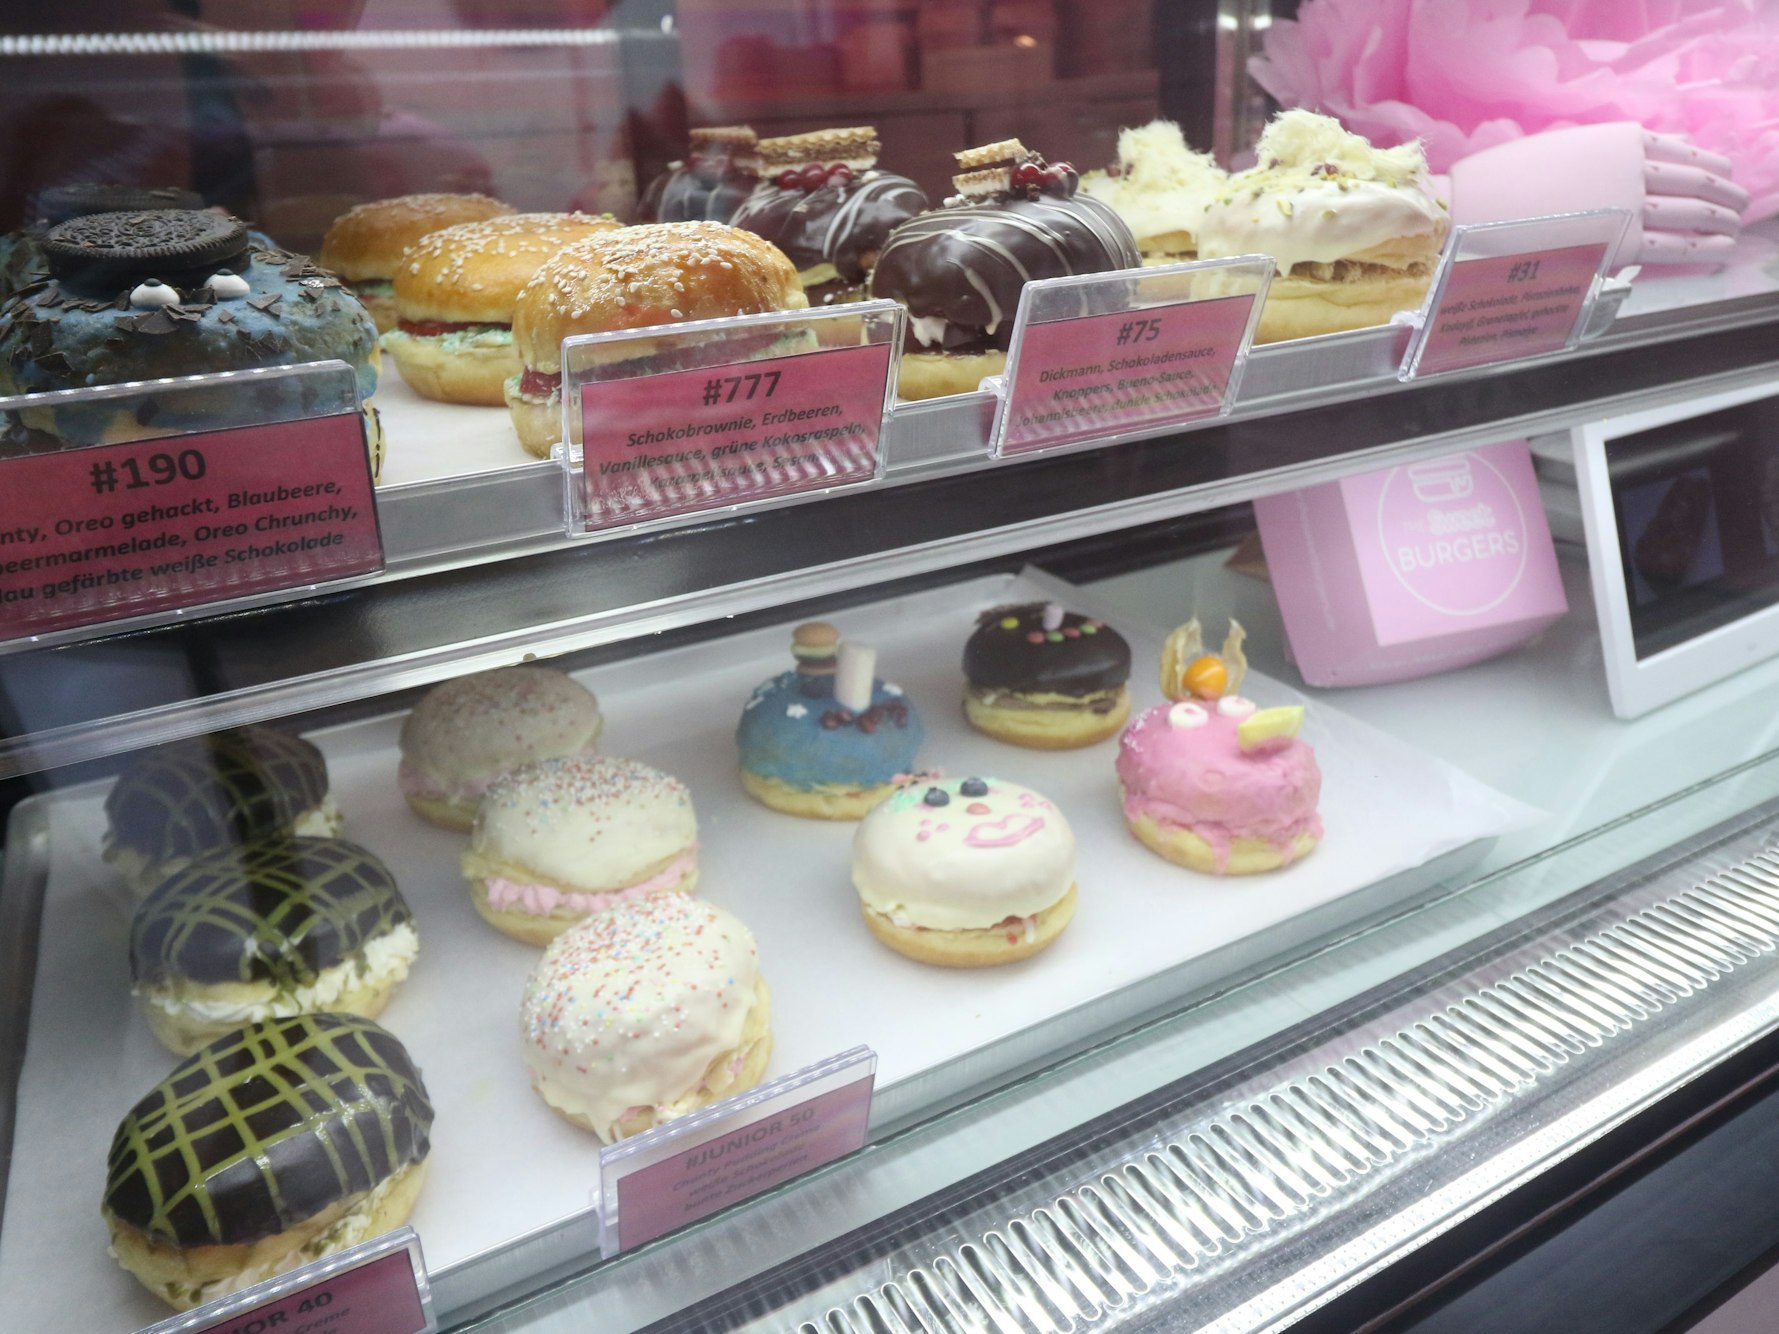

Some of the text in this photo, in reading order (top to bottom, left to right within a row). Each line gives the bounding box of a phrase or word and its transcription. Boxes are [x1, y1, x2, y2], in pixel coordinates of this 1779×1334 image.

[1507, 261, 1541, 283] #31
[1117, 318, 1162, 345] #75
[1039, 346, 1216, 383] Dickmann, Schokoladensauce,
[703, 371, 782, 406] #777
[1053, 380, 1114, 402] Knoppers,
[627, 404, 843, 448] Schokobrownie, Erdbeeren,
[599, 423, 866, 476] Vanillesauce, grüne Kokosraspeln,
[90, 449, 206, 493] #190
[650, 461, 767, 488] Karamelsauce,
[55, 512, 113, 536] Oreo
[121, 496, 220, 529] gehackt,
[227, 481, 342, 509] Blaubeere,
[194, 522, 248, 543] Oreo
[255, 504, 358, 533] Chrunchy,
[43, 565, 143, 598] gefärbte
[150, 553, 218, 578] weiße
[224, 532, 344, 565] Schokolade
[1398, 529, 1520, 571] BURGERS
[686, 1107, 815, 1170] #JUNIOR 50
[297, 1291, 333, 1314] 40
